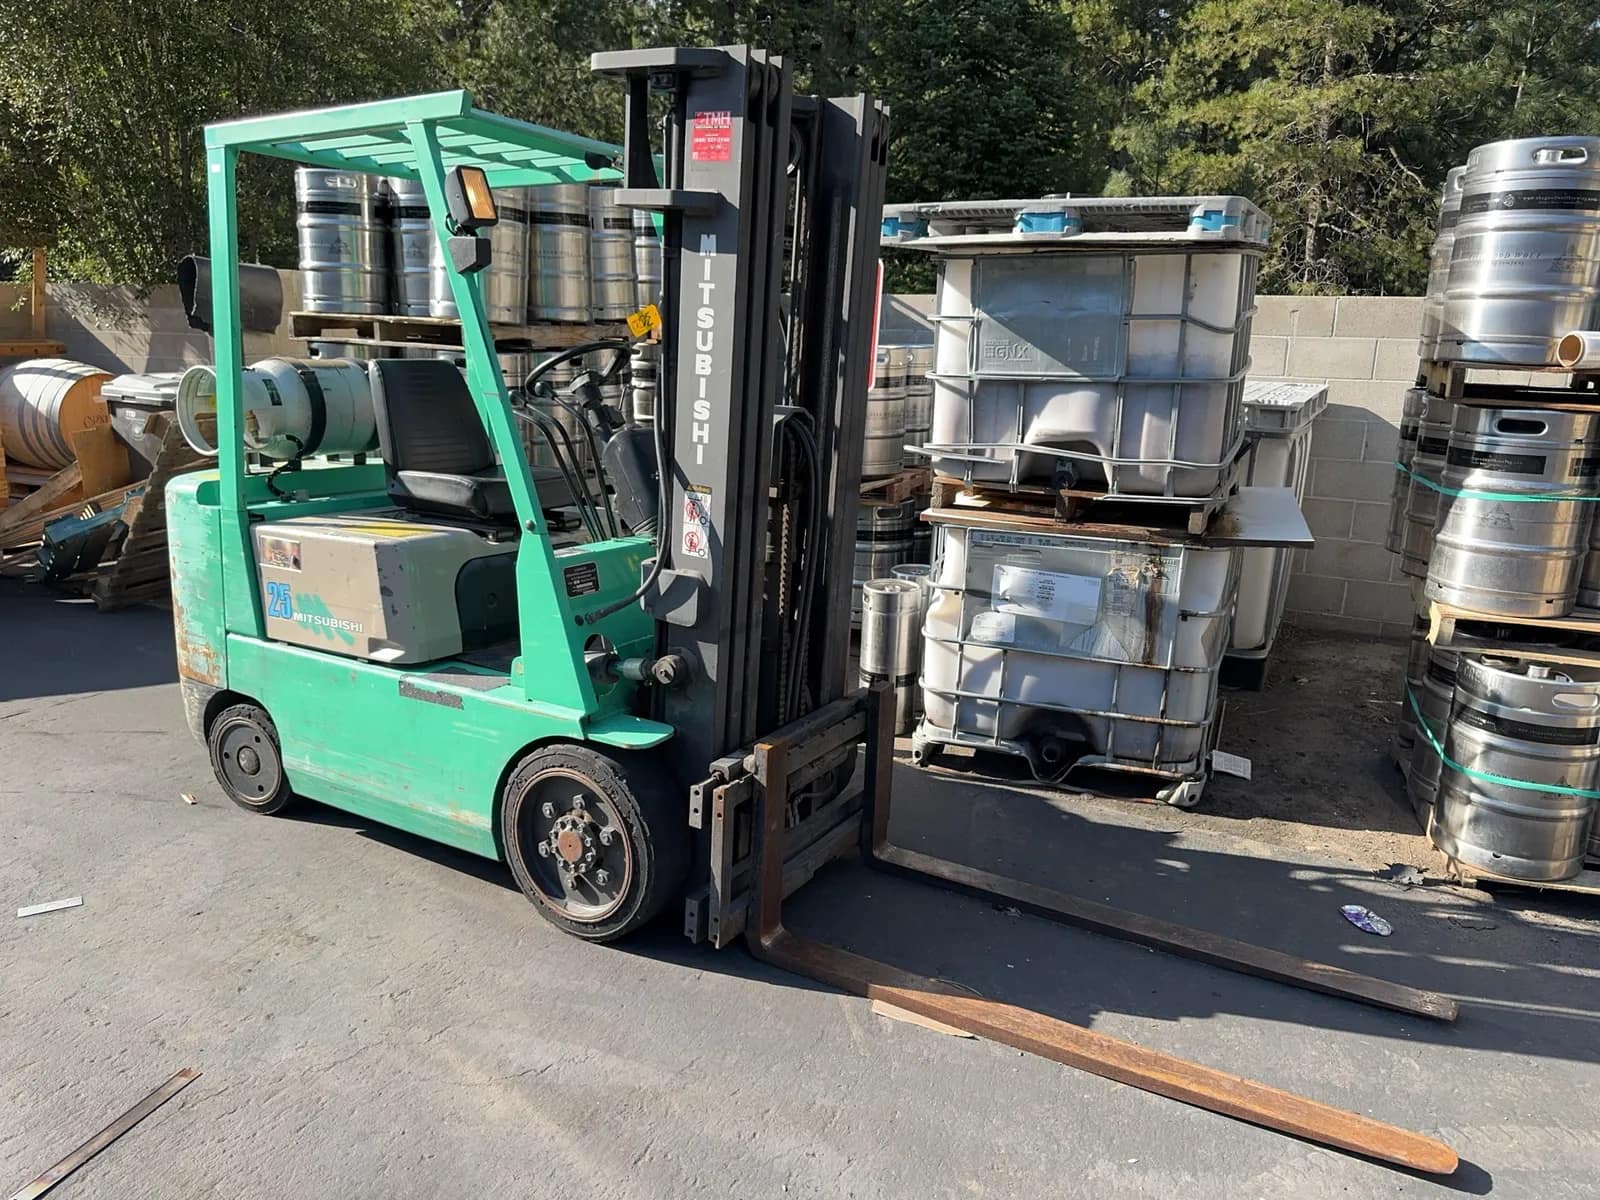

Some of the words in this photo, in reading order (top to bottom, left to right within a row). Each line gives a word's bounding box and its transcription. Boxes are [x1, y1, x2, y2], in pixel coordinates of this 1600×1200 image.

[704, 111, 731, 125] TMH
[692, 233, 717, 465] MITSUBISHI
[266, 580, 293, 620] 25
[293, 612, 363, 633] MITSUBISHI
